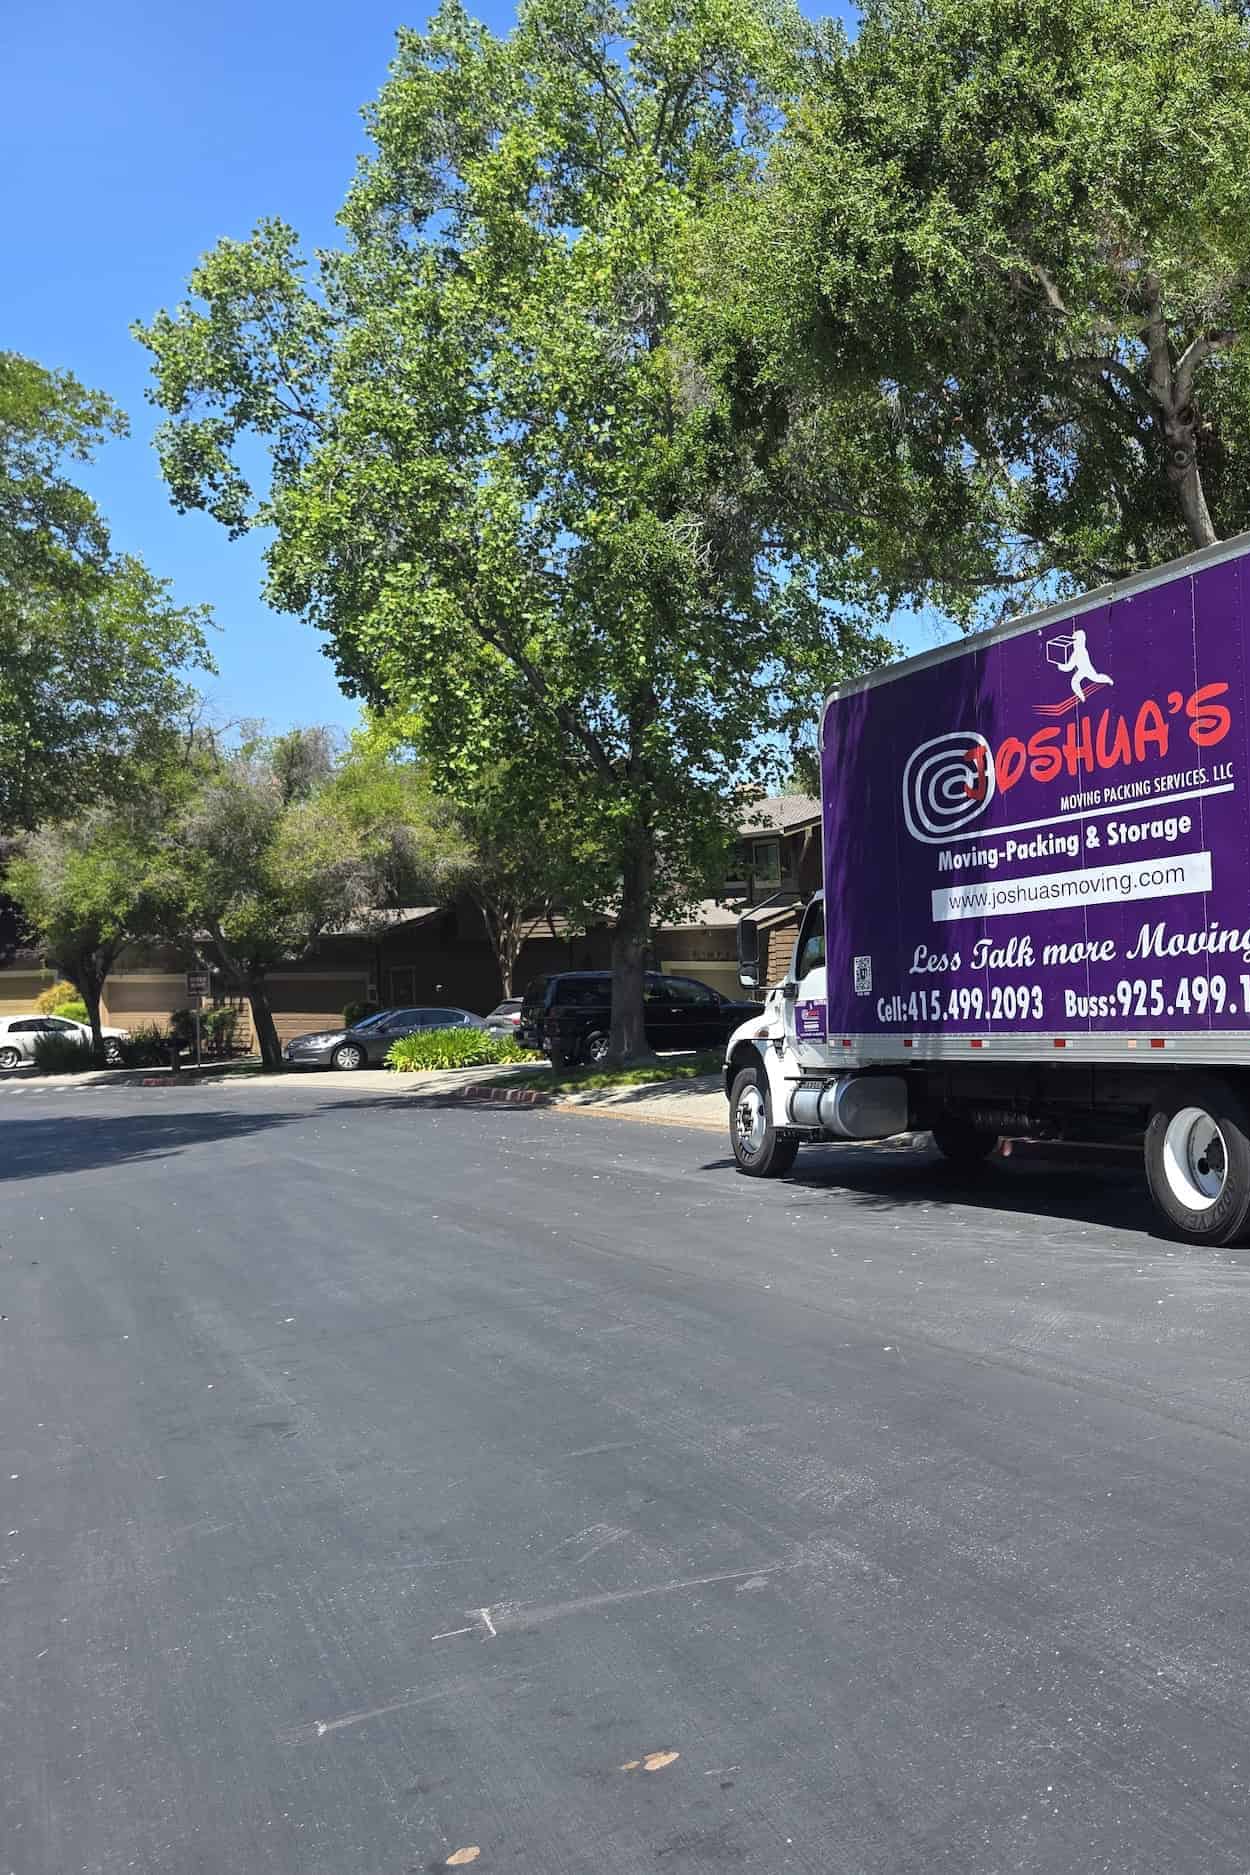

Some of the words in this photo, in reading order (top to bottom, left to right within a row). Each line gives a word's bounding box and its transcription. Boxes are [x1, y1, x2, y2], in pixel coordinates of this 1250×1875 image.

[963, 682, 1232, 801] JOSHUA'S
[1060, 791, 1101, 811] MOVING
[1103, 780, 1151, 803] PACKING
[1213, 762, 1234, 781] LLC
[938, 833, 1079, 872] Moving-Packing
[1086, 825, 1101, 848] &
[1107, 815, 1192, 846] Storage
[948, 865, 1186, 909] www.joshuasmoving.com
[908, 944, 962, 975] Less
[970, 935, 1036, 970] Talk
[1043, 938, 1117, 966] more
[877, 985, 1044, 1023] Cell:415.499.2093
